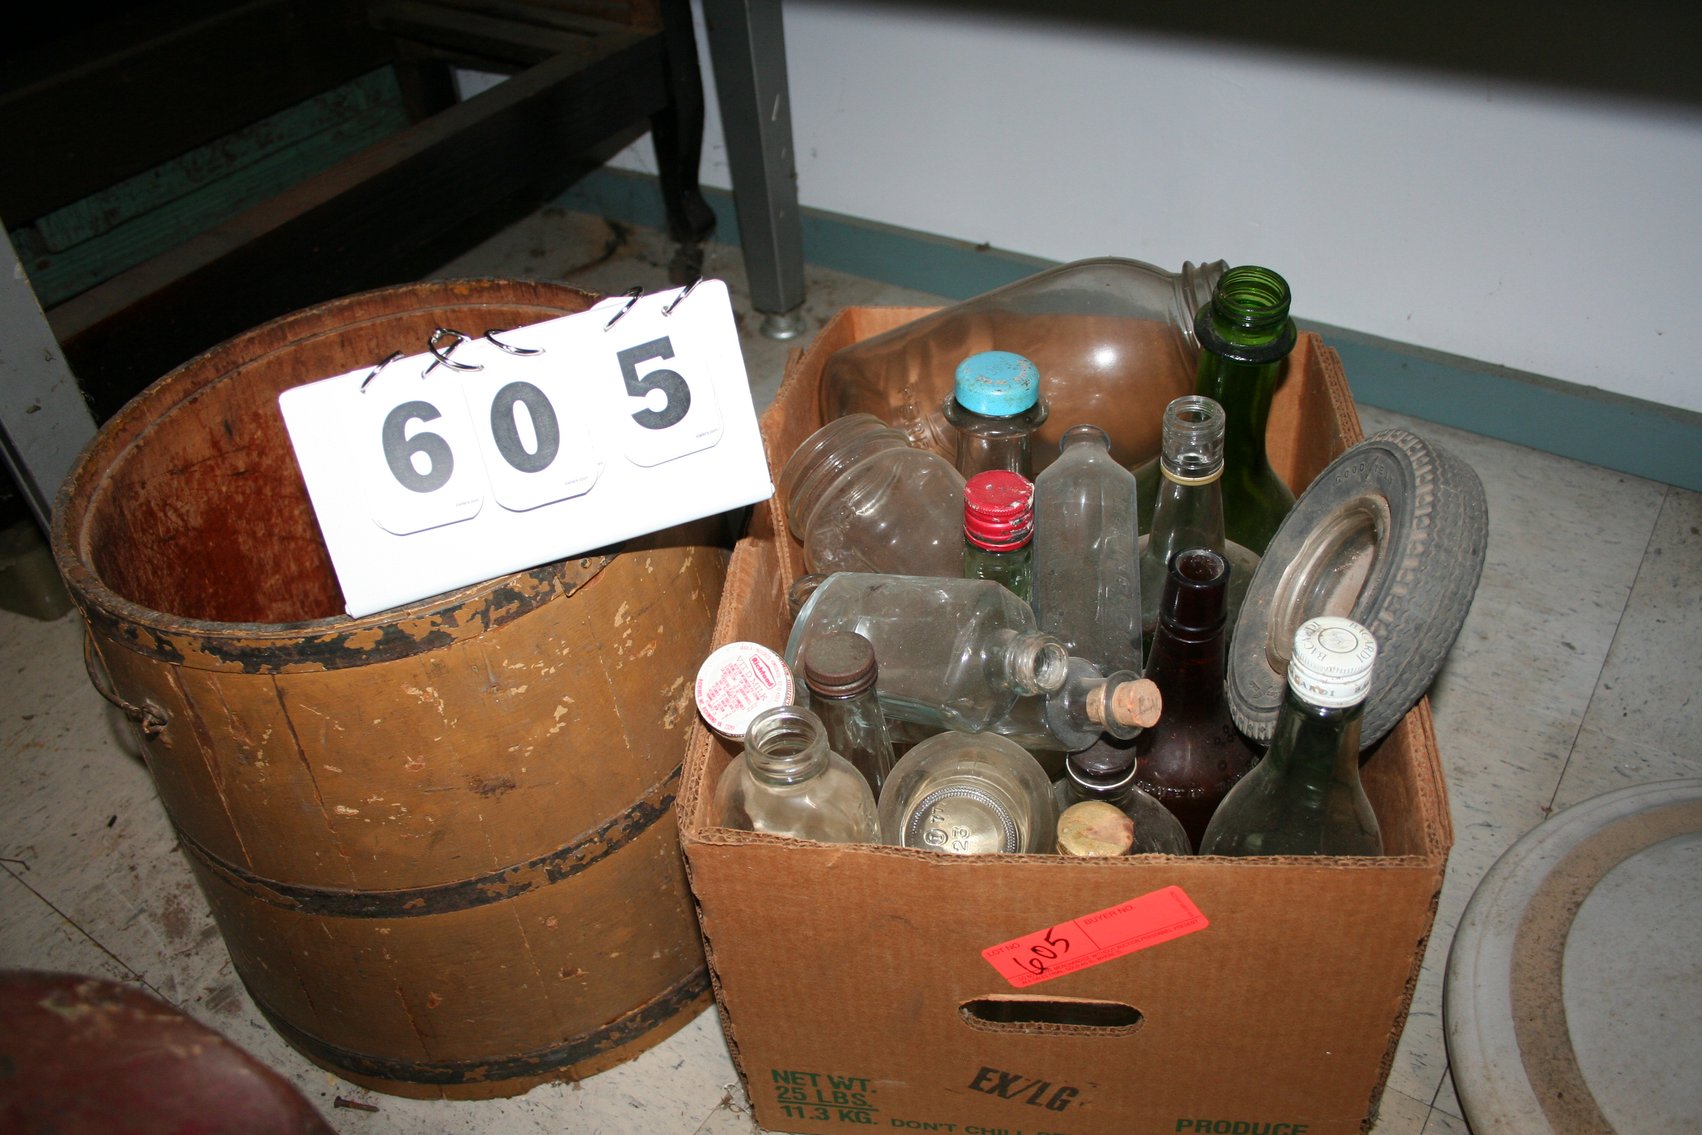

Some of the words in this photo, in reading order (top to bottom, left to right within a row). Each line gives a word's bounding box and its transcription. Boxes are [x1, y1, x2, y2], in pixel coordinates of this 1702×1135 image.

[1013, 927, 1071, 976] 605
[770, 1069, 822, 1087] NET
[827, 1074, 878, 1093] WT.
[968, 1065, 1079, 1112] EX/LG
[776, 1085, 808, 1102] 25
[816, 1089, 873, 1108] LBS.
[780, 1105, 830, 1121] 11.3
[839, 1109, 878, 1125] KG.
[890, 1118, 957, 1133] DON'T
[1176, 1118, 1310, 1135] PRODUCE
